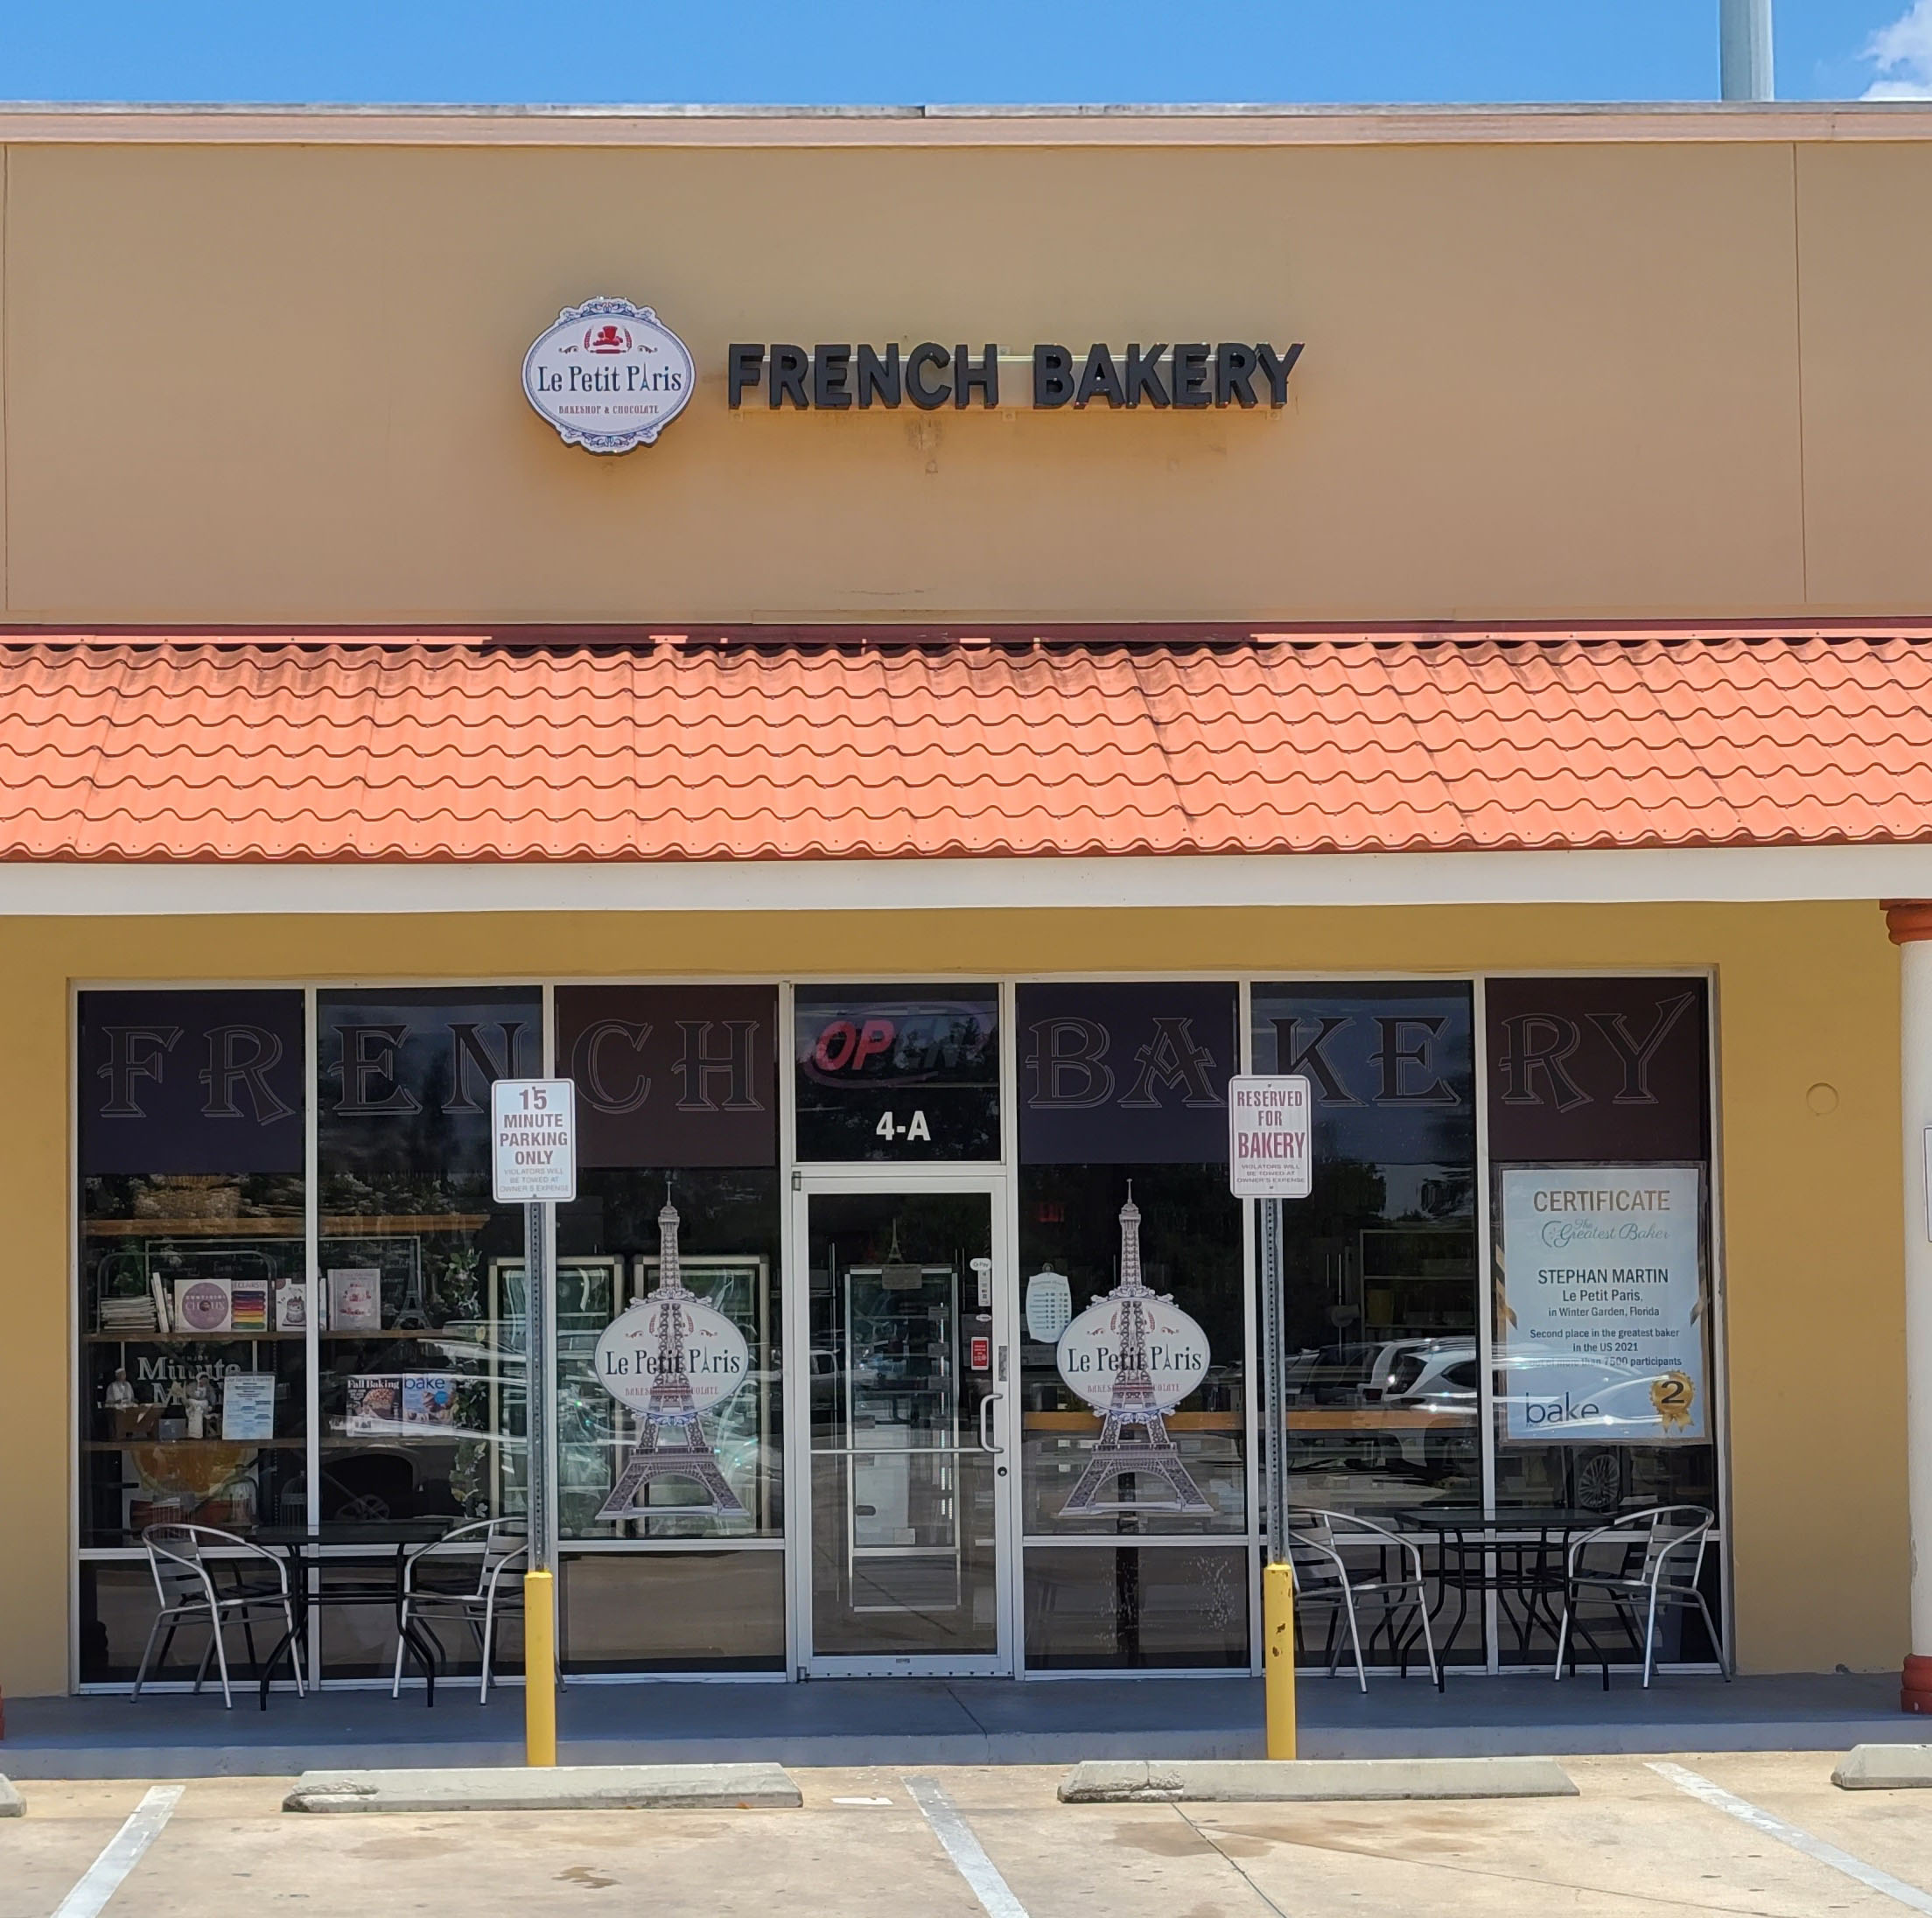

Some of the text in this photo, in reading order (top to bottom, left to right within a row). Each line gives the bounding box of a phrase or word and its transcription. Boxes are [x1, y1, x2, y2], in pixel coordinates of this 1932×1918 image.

[537, 366, 563, 392] Le
[569, 366, 620, 392] Petit
[728, 342, 1305, 410] FRENCH BAKERY
[558, 404, 659, 414] BAKESHOP & CHOCOLATE
[519, 1088, 548, 1110] 15
[1236, 1090, 1303, 1107] RESERVED
[503, 1113, 564, 1128] MINUTE
[876, 1110, 931, 1142] 4-A
[1258, 1110, 1283, 1126] FOR
[500, 1131, 568, 1147] PARKING
[1237, 1132, 1306, 1158] BAKERY
[514, 1150, 554, 1166] ONLY
[1534, 1190, 1670, 1213] CERTIFICATE
[1542, 1221, 1671, 1249] Greatest Baker
[1537, 1268, 1669, 1284] STEPHAN MARTIN
[1562, 1290, 1577, 1302] Le
[1579, 1289, 1609, 1301] Petit
[1548, 1306, 1660, 1318] in Winter Garden, Florida
[1530, 1327, 1680, 1340] Second place in the greatest baker
[1572, 1342, 1639, 1352] in the US 2021
[606, 1350, 628, 1375] Le
[1068, 1348, 1090, 1372] Le
[1630, 1356, 1683, 1367] participants
[137, 1356, 242, 1381] Minute
[347, 1380, 399, 1390] Fall Baking
[404, 1376, 445, 1390] bake
[1660, 1380, 1685, 1404] 2
[1525, 1391, 1600, 1424] bake
